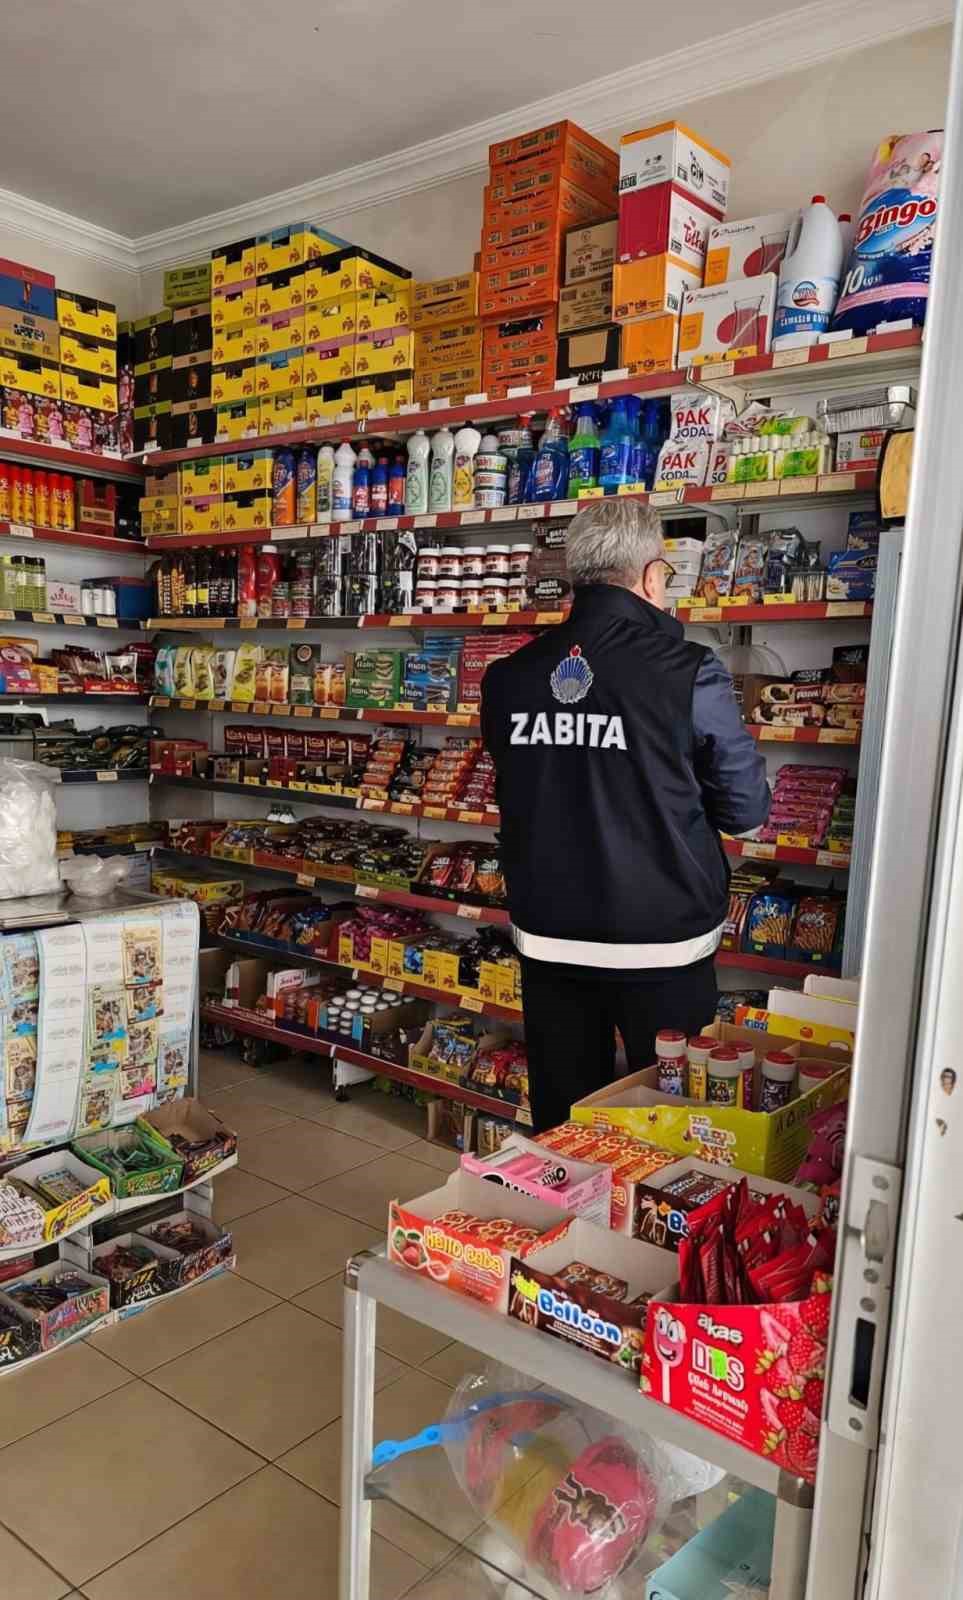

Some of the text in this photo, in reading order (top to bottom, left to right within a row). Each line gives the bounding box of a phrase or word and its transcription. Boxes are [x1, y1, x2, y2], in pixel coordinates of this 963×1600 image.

[855, 199, 937, 242] Bingo
[676, 408, 711, 428] PAK
[661, 451, 697, 471] PAK
[510, 712, 628, 751] ZABITA
[539, 1290, 620, 1344] Balloon
[697, 1312, 743, 1345] akas
